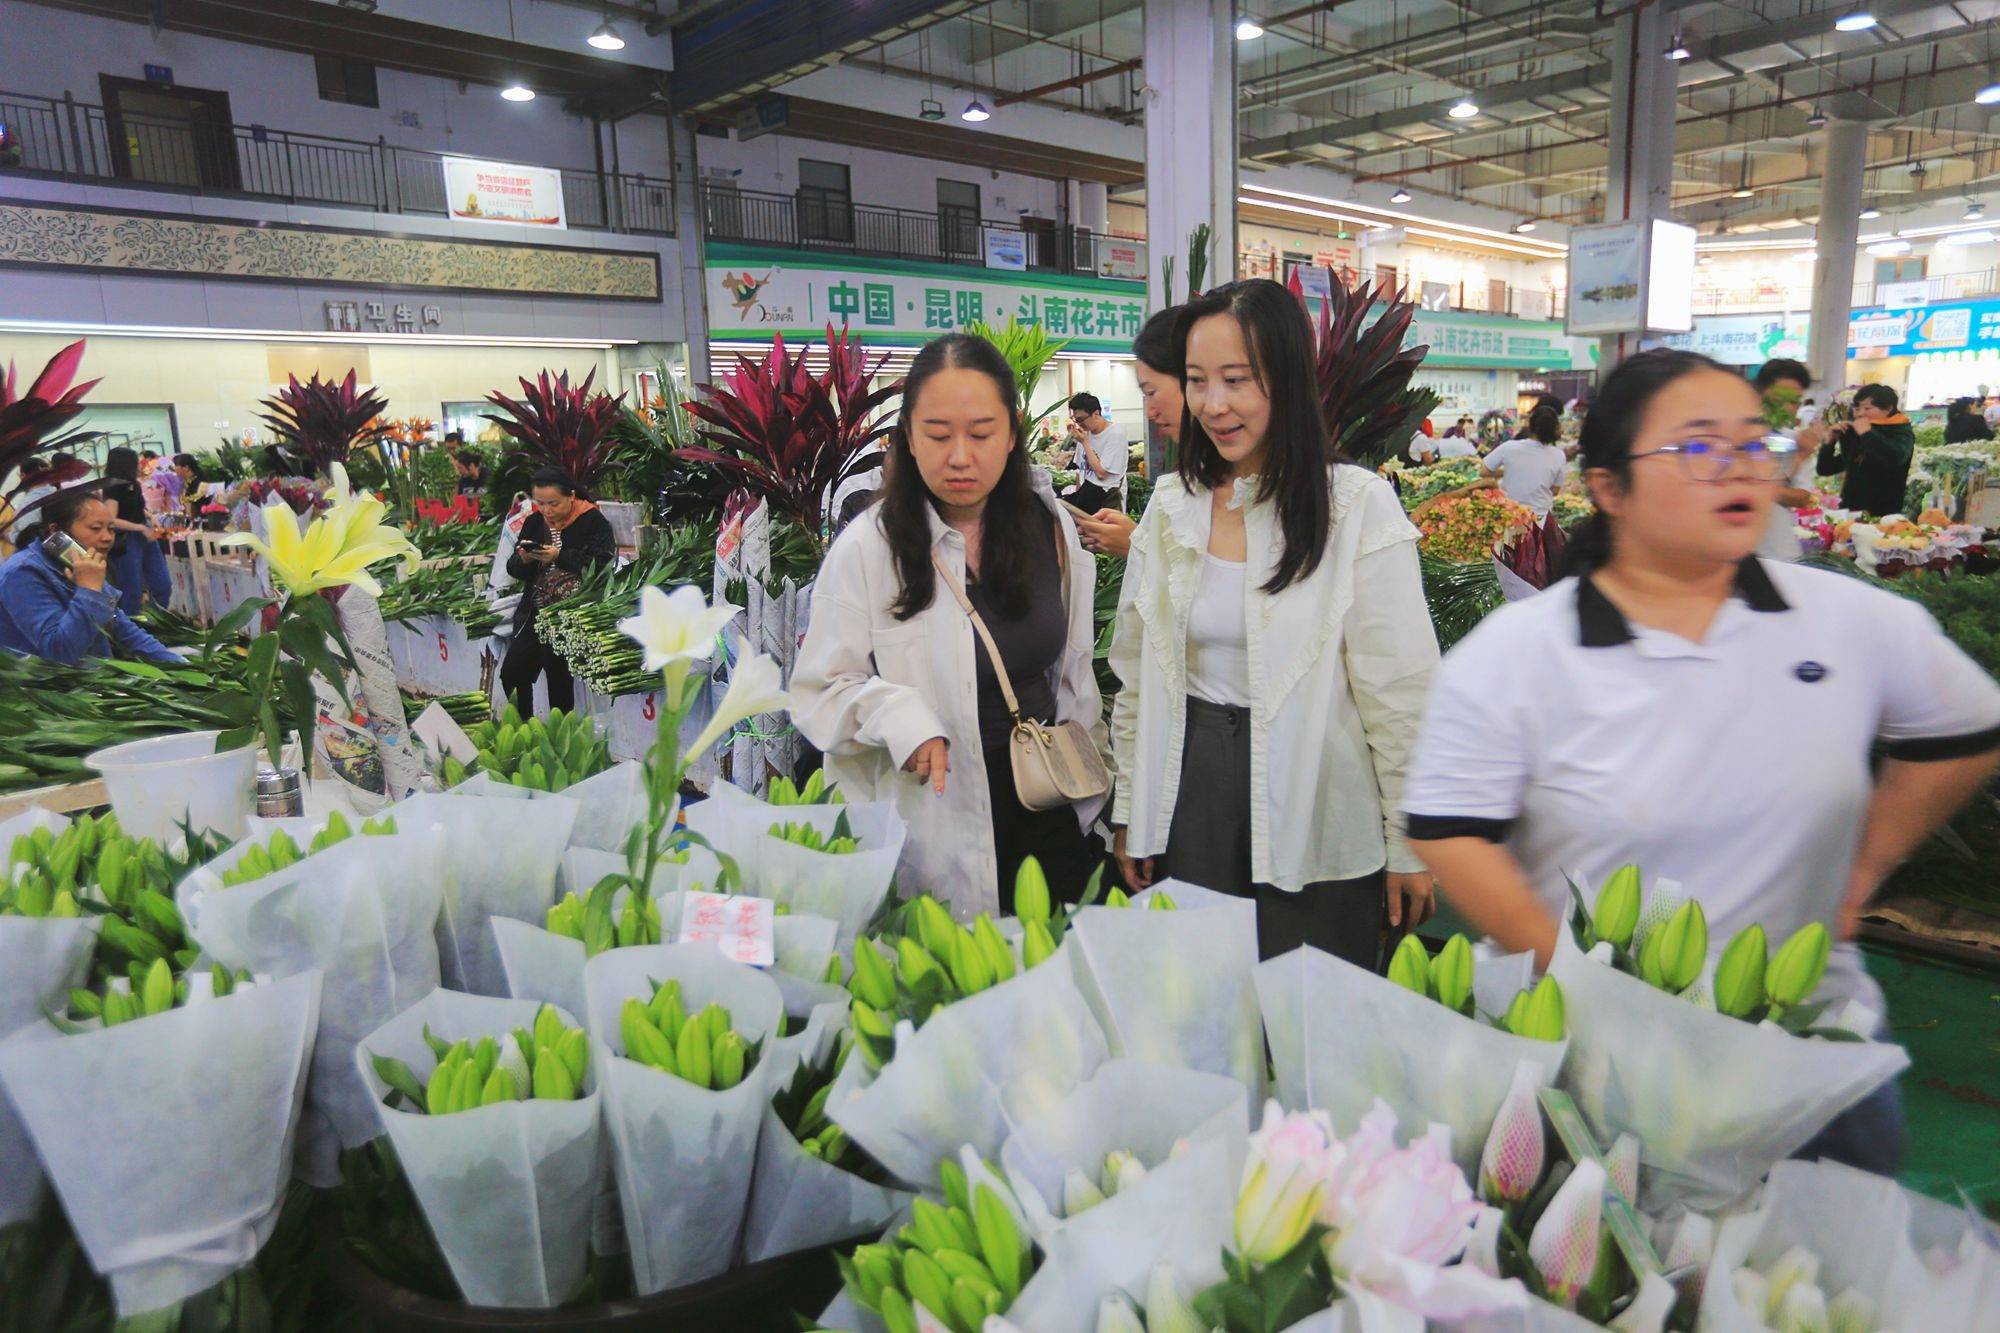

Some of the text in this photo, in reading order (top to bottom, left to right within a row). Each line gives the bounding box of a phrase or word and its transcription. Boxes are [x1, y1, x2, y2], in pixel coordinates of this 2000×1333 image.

[366, 301, 442, 326] 卫生间
[828, 280, 1150, 338] 中国·昆明·斗南花卉市
[436, 631, 449, 662] 5
